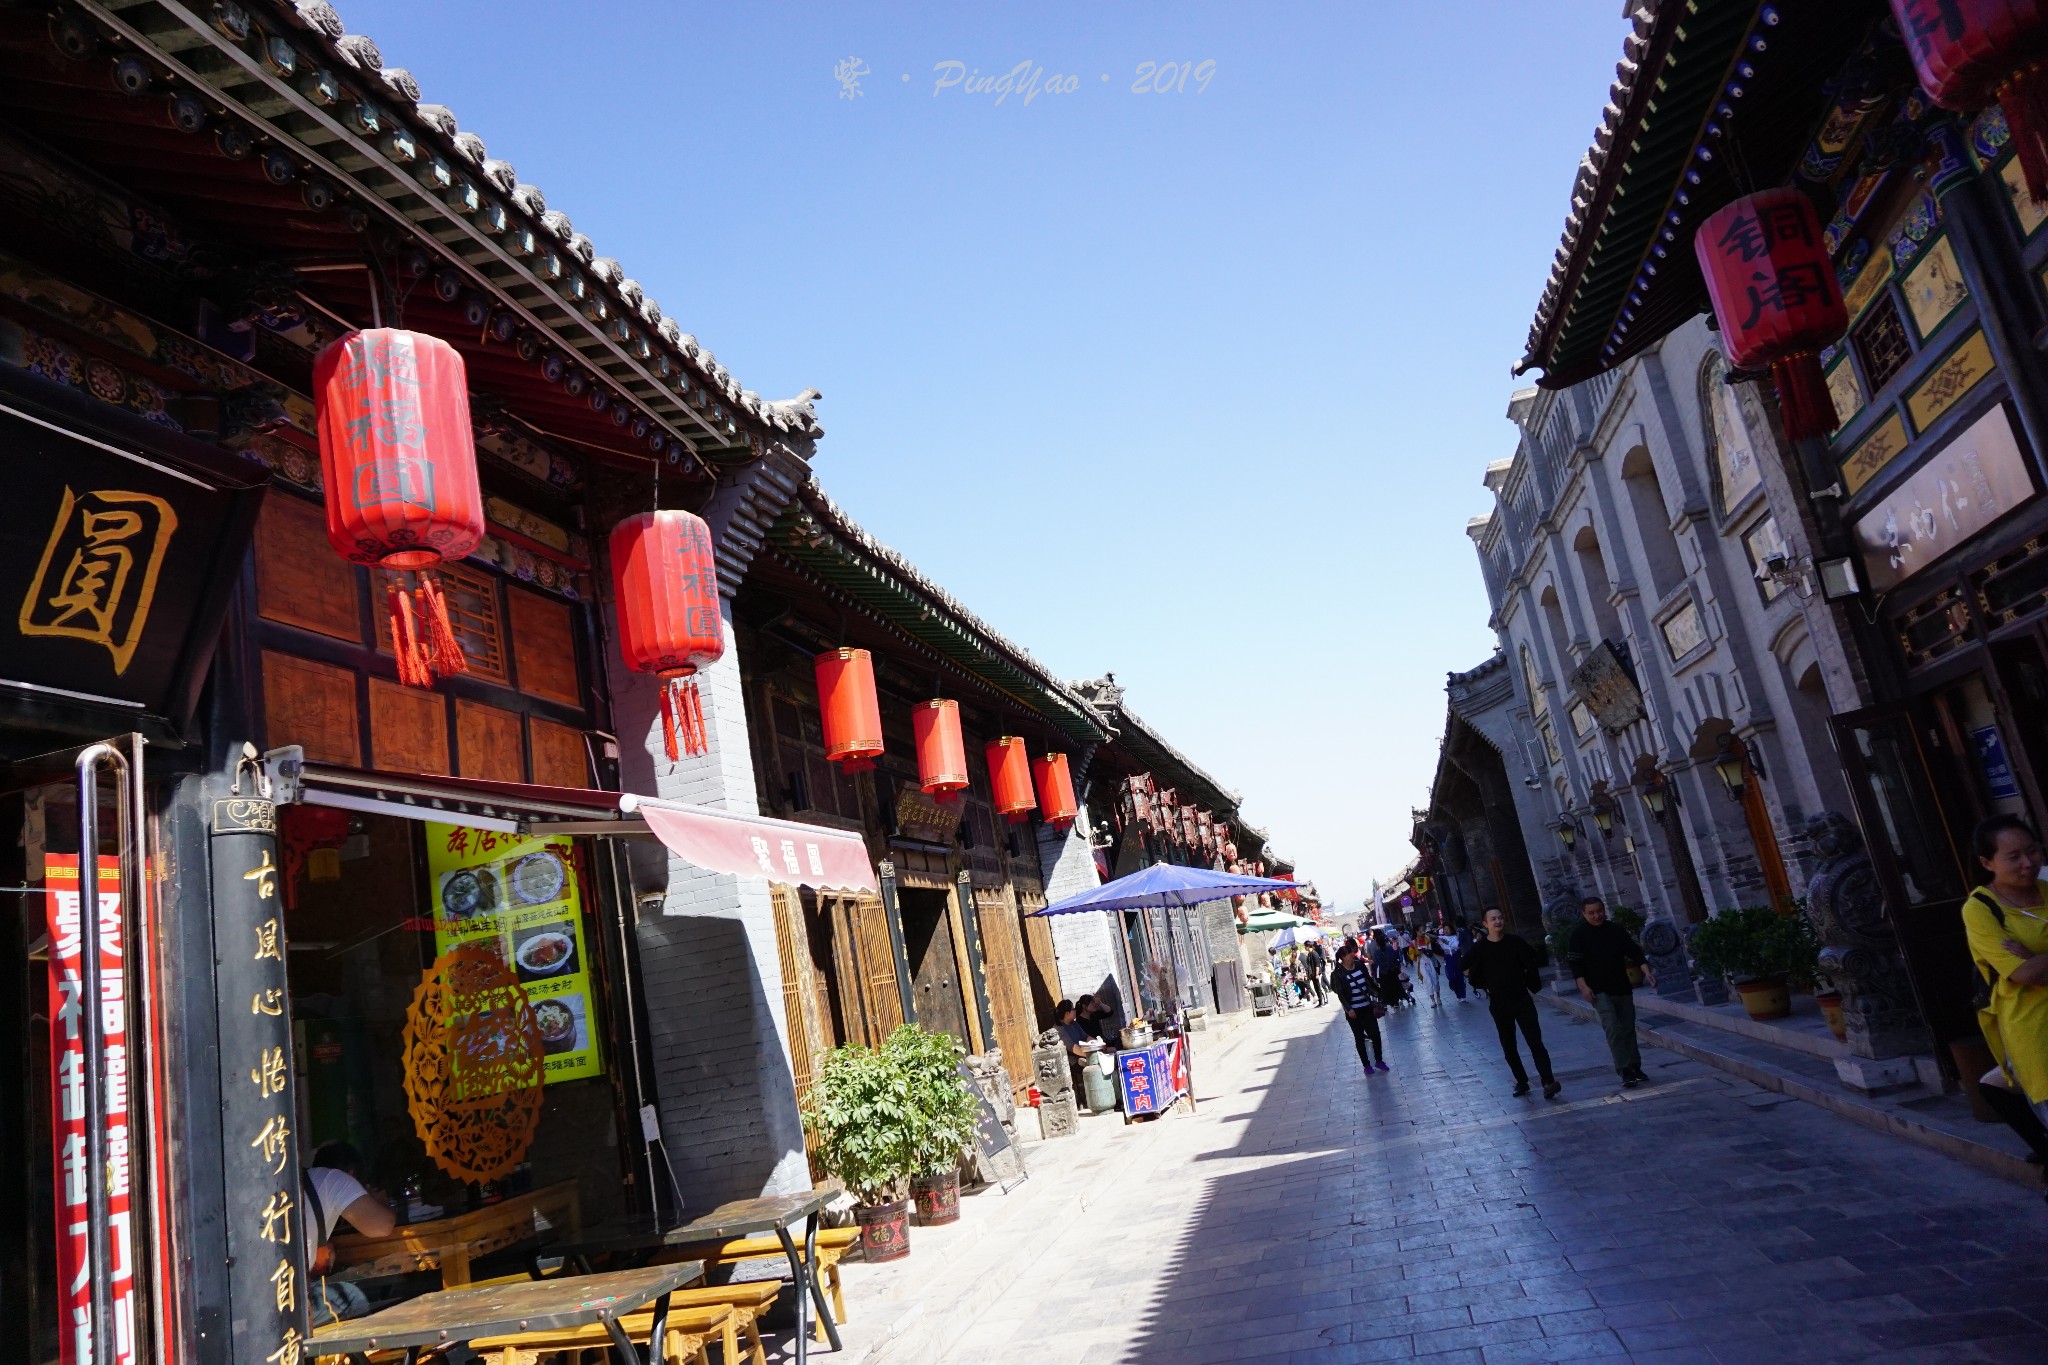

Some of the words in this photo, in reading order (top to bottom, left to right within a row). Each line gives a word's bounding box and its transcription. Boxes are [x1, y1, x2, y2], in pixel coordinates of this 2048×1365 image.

[19, 485, 179, 677] 圓
[1127, 1057, 1152, 1110] 香草肉
